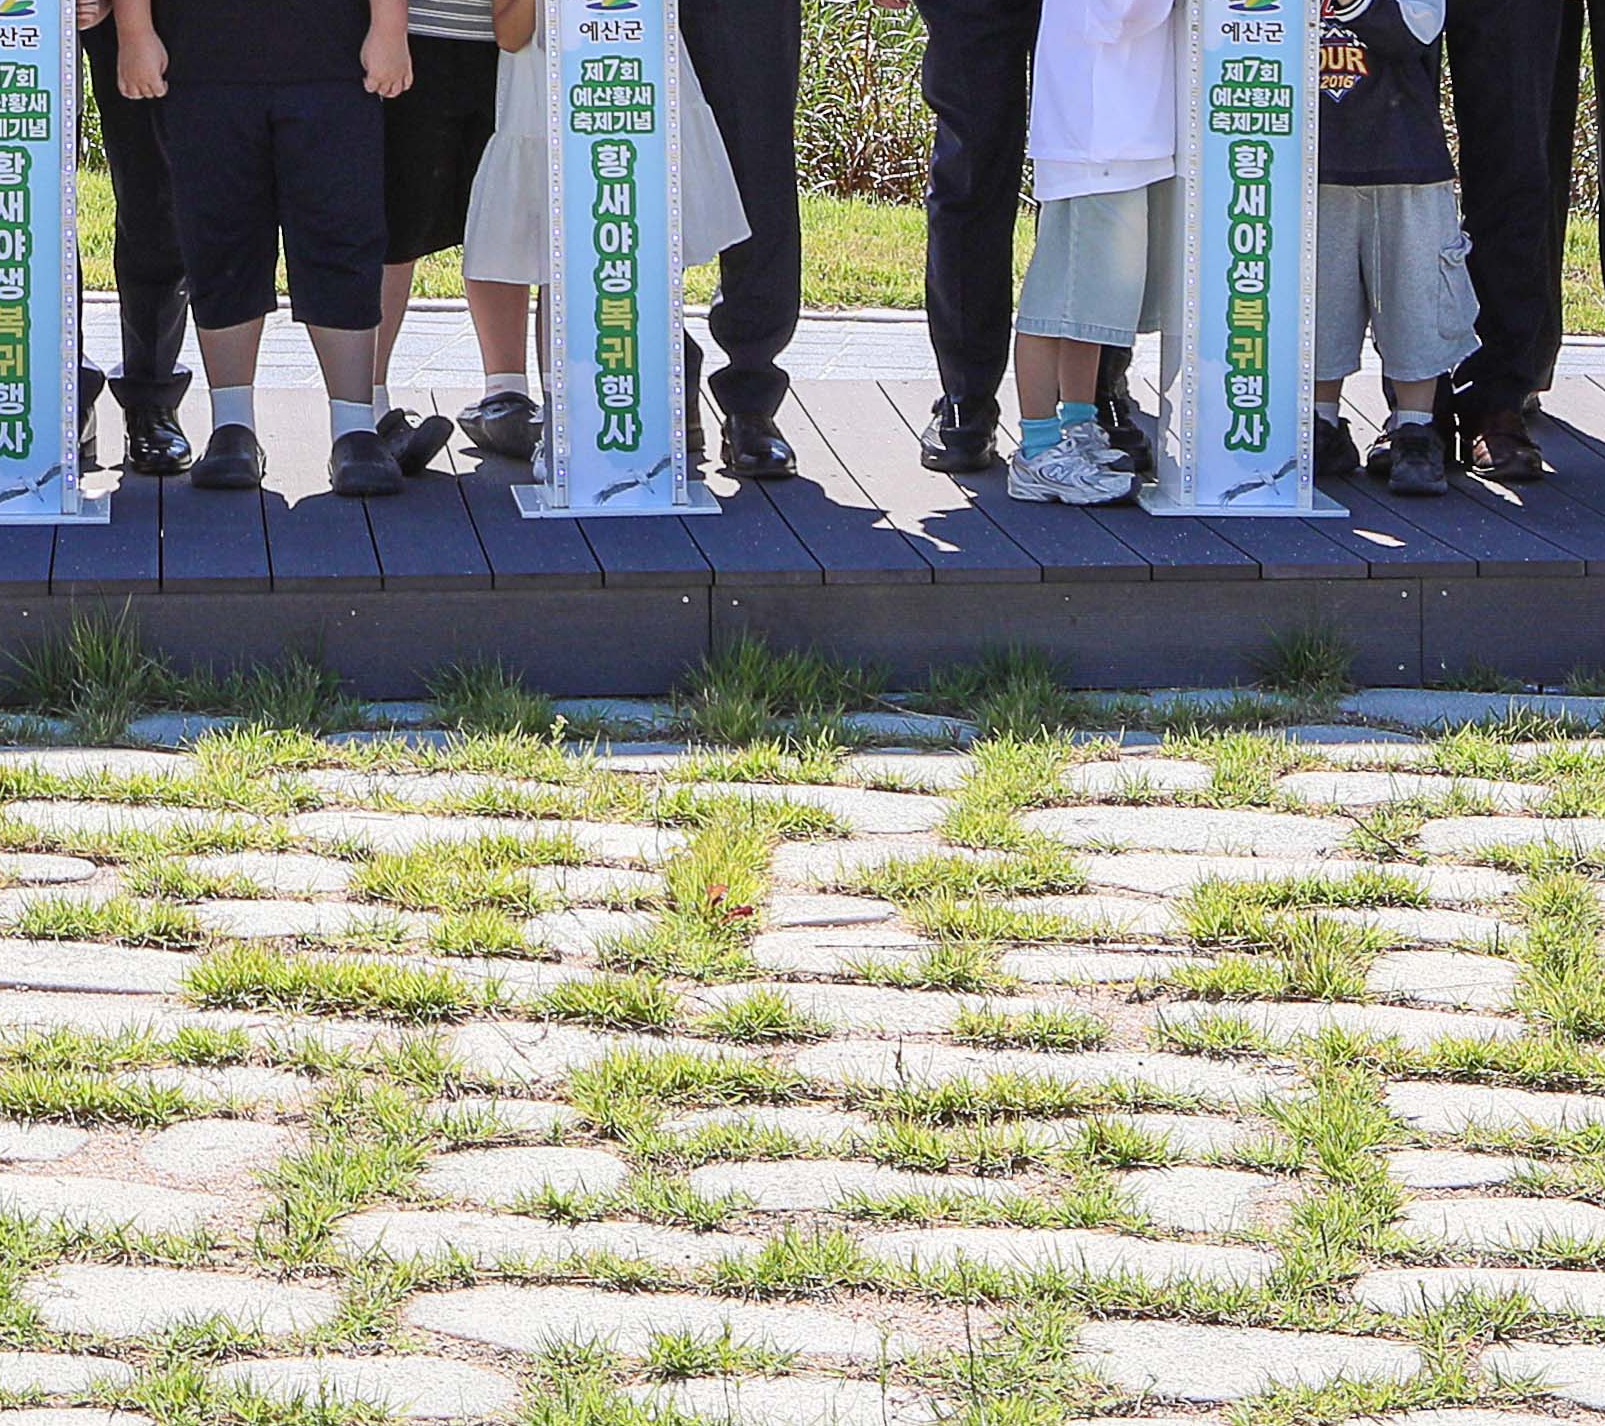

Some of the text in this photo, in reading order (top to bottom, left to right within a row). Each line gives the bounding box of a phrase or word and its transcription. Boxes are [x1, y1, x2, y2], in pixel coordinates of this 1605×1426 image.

[579, 20, 643, 42] 예산군
[1220, 21, 1284, 44] 예산군
[583, 58, 639, 84] 제7회
[1223, 59, 1279, 85] 제7회
[1319, 75, 1354, 89] 2016
[572, 86, 652, 109] 예산황새
[1212, 86, 1291, 109] 예산황새
[572, 110, 652, 133] 축제기념
[1212, 110, 1289, 134] 축제기념
